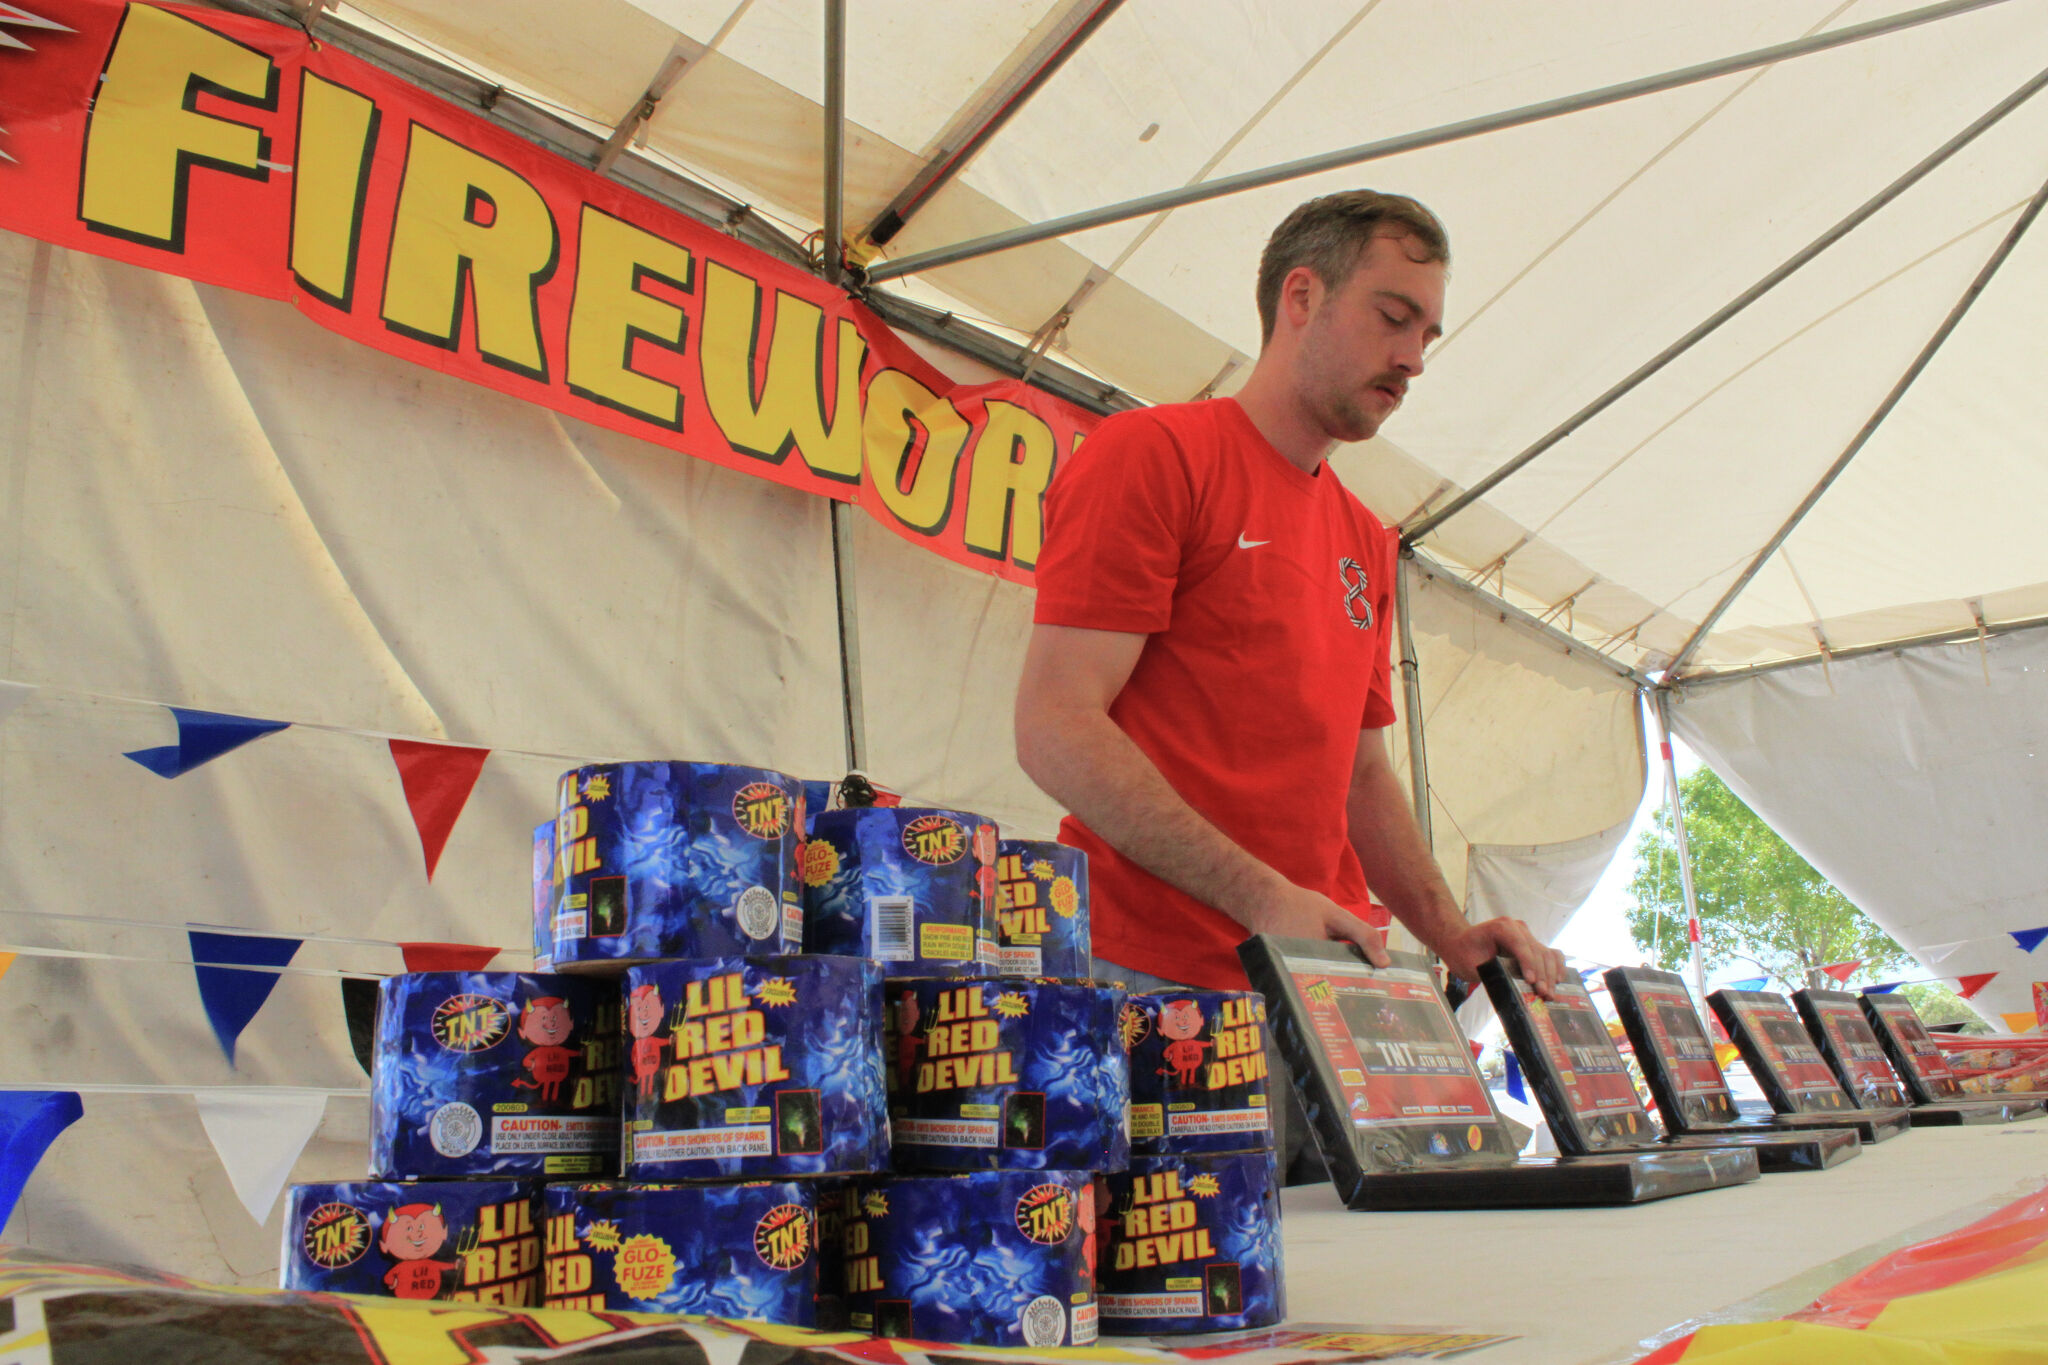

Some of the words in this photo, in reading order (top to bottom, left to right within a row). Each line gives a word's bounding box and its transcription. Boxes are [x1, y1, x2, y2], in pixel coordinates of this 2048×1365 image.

[78, 1, 1086, 571] FIREWOR
[747, 796, 785, 826] TNT
[916, 826, 955, 855] TNT
[805, 860, 832, 876] FUZE
[685, 972, 751, 1018] LIL
[938, 986, 989, 1022] LIL
[1307, 980, 1330, 1001] TNT
[445, 1003, 496, 1043] TNT
[1222, 997, 1256, 1027] LIL
[675, 1009, 766, 1060] RED
[927, 1019, 999, 1058] RED
[1216, 1024, 1262, 1059] RED
[1207, 1050, 1269, 1090] DEVIL
[1375, 1041, 1416, 1067] TNT
[664, 1044, 790, 1104] DEVIL
[916, 1052, 1019, 1094] DEVIL
[501, 1119, 562, 1132] CAUTION-
[1171, 1114, 1209, 1125] CAUTION-
[686, 1133, 722, 1145] SHOWERS
[723, 1132, 733, 1143] OF
[734, 1130, 766, 1143] SPARKS
[686, 1146, 715, 1156] CAUTIONS
[716, 1145, 725, 1154] ON
[727, 1144, 747, 1154] BACK
[748, 1143, 770, 1153] PANEL
[960, 1135, 977, 1144] BACK
[1133, 1170, 1186, 1206] LIL
[479, 1199, 535, 1243] LIL
[1029, 1195, 1067, 1235] TNT
[1124, 1200, 1198, 1238] RED
[313, 1214, 357, 1255] TNT
[767, 1214, 804, 1258] TNT
[1115, 1228, 1217, 1272] DEVIL
[464, 1236, 540, 1286] RED
[623, 1247, 668, 1264] GLO-
[623, 1264, 665, 1281] FUZE
[411, 1279, 435, 1291] RED
[1174, 1296, 1198, 1304] SPARKS
[1167, 1306, 1184, 1314] BACK
